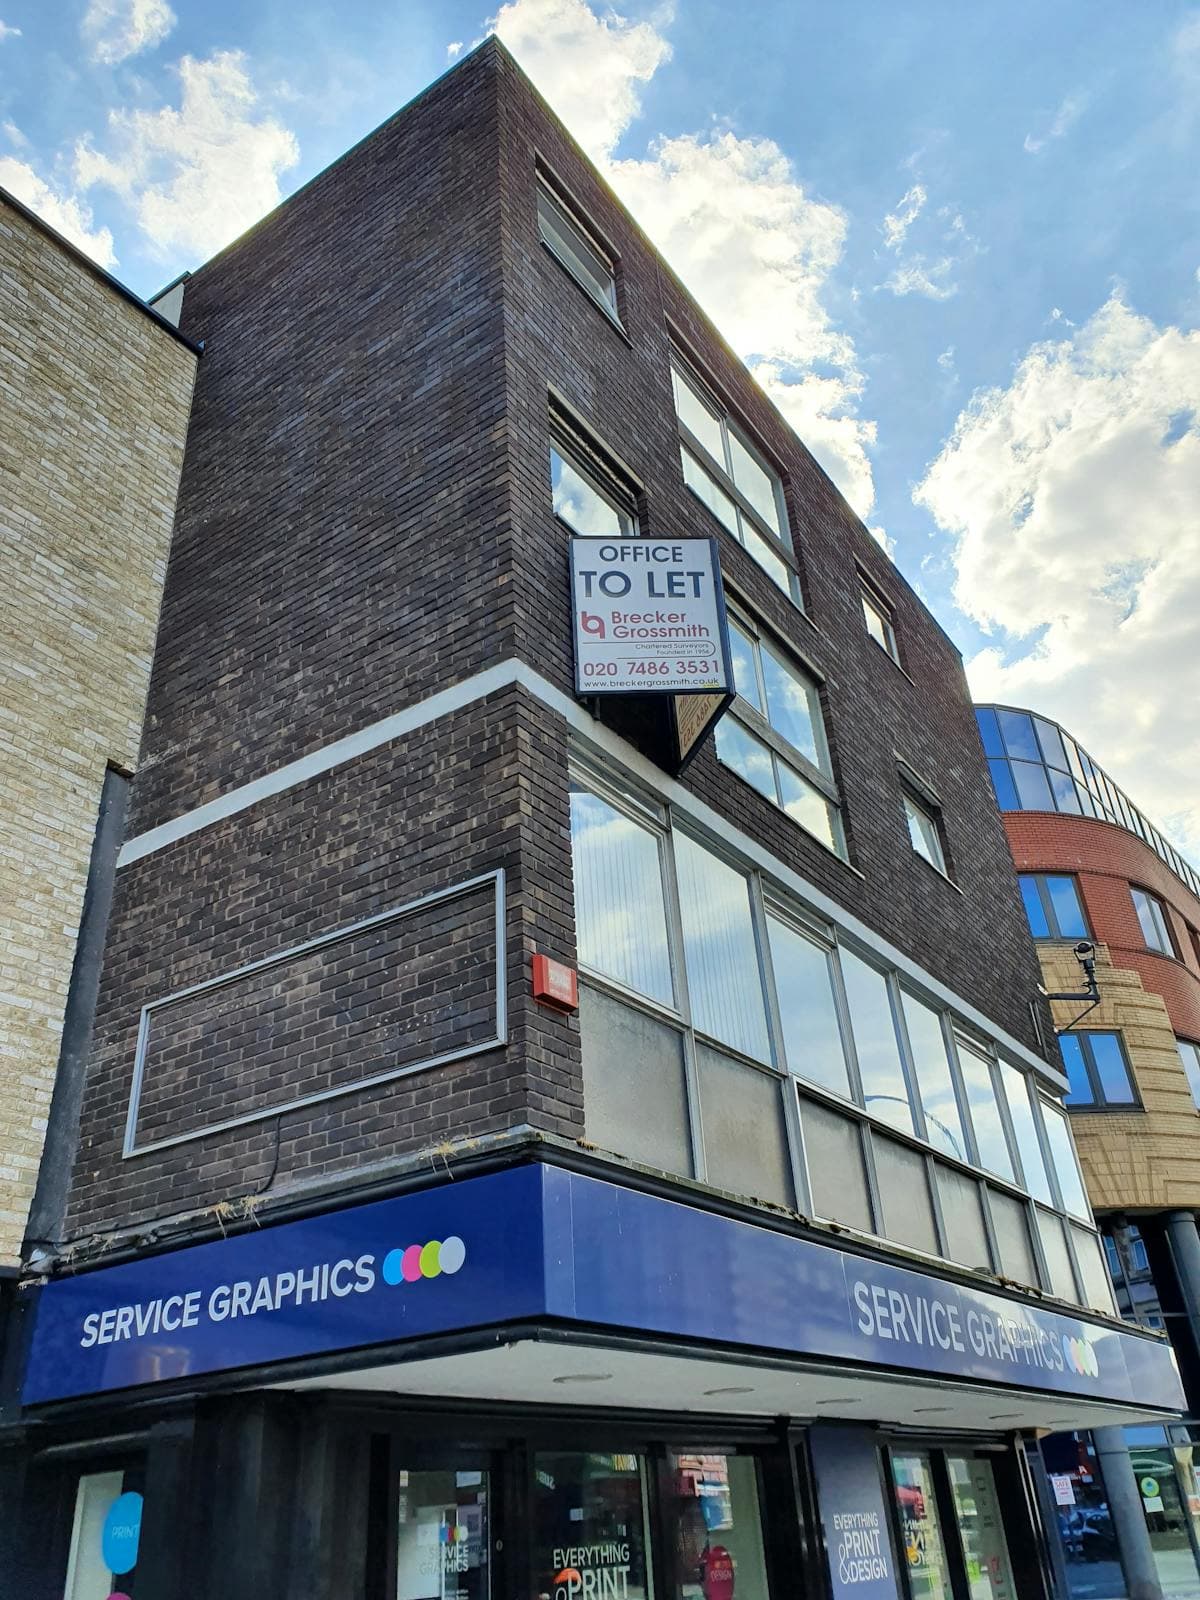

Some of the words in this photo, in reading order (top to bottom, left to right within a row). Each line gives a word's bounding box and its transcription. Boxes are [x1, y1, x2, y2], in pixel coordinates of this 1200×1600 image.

[599, 546, 683, 562] OFFICE
[579, 571, 632, 598] TO
[647, 572, 705, 598] LET
[612, 611, 686, 624] Brecker
[613, 624, 709, 638] Grossmith
[584, 662, 618, 676] 020
[627, 661, 670, 675] 7486
[676, 660, 719, 674] 3531
[584, 678, 719, 688] www.breckergrossmith.co.uk
[80, 1291, 202, 1348] SERVICE
[208, 1254, 376, 1322] GRAPHICS
[854, 1281, 966, 1353] SERVICE
[966, 1311, 1065, 1373] GRAPHICS
[833, 1512, 879, 1530] EVERYTHING
[112, 1525, 140, 1538] PRINT
[843, 1529, 880, 1559] PRINT
[553, 1543, 630, 1569] EVERYTHING
[567, 1565, 631, 1600] PRINT
